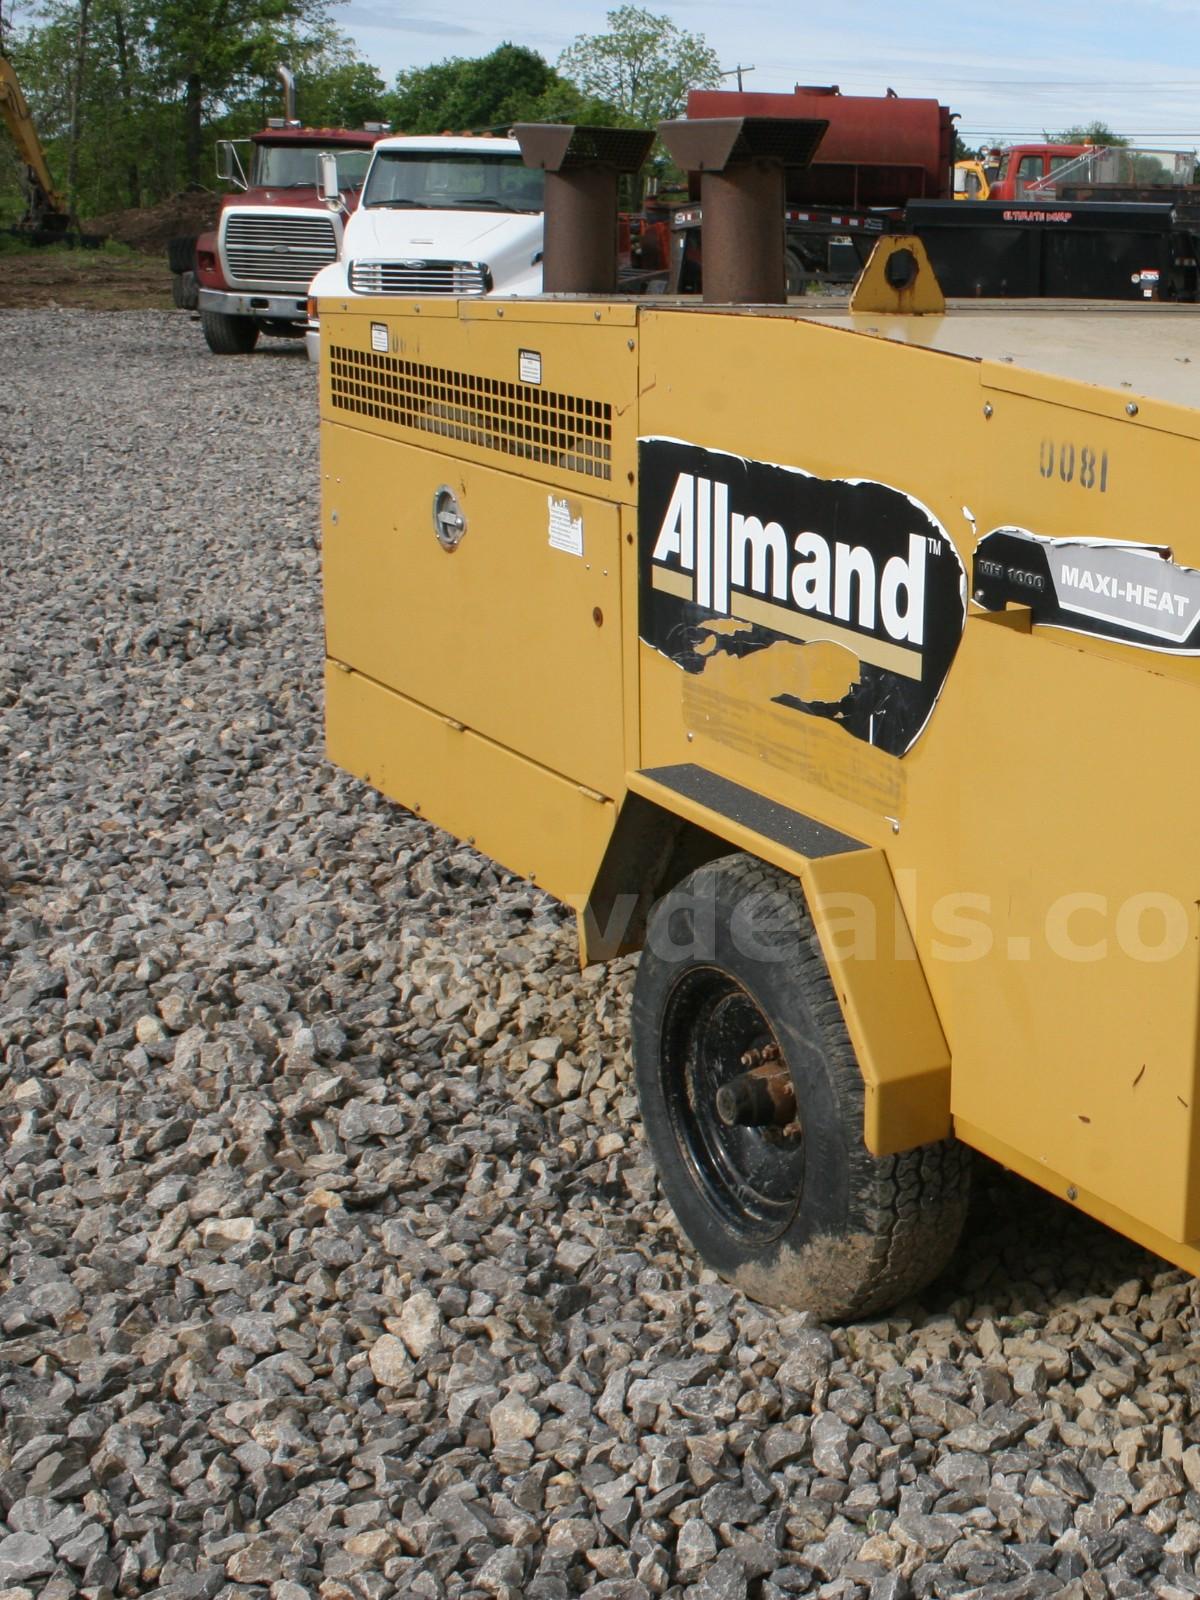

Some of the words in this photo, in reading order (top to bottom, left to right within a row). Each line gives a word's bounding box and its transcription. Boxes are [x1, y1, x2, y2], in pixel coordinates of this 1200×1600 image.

[1039, 440, 1109, 493] 0081
[652, 472, 928, 646] Allmand
[1060, 565, 1190, 617] MAXI-HEAT
